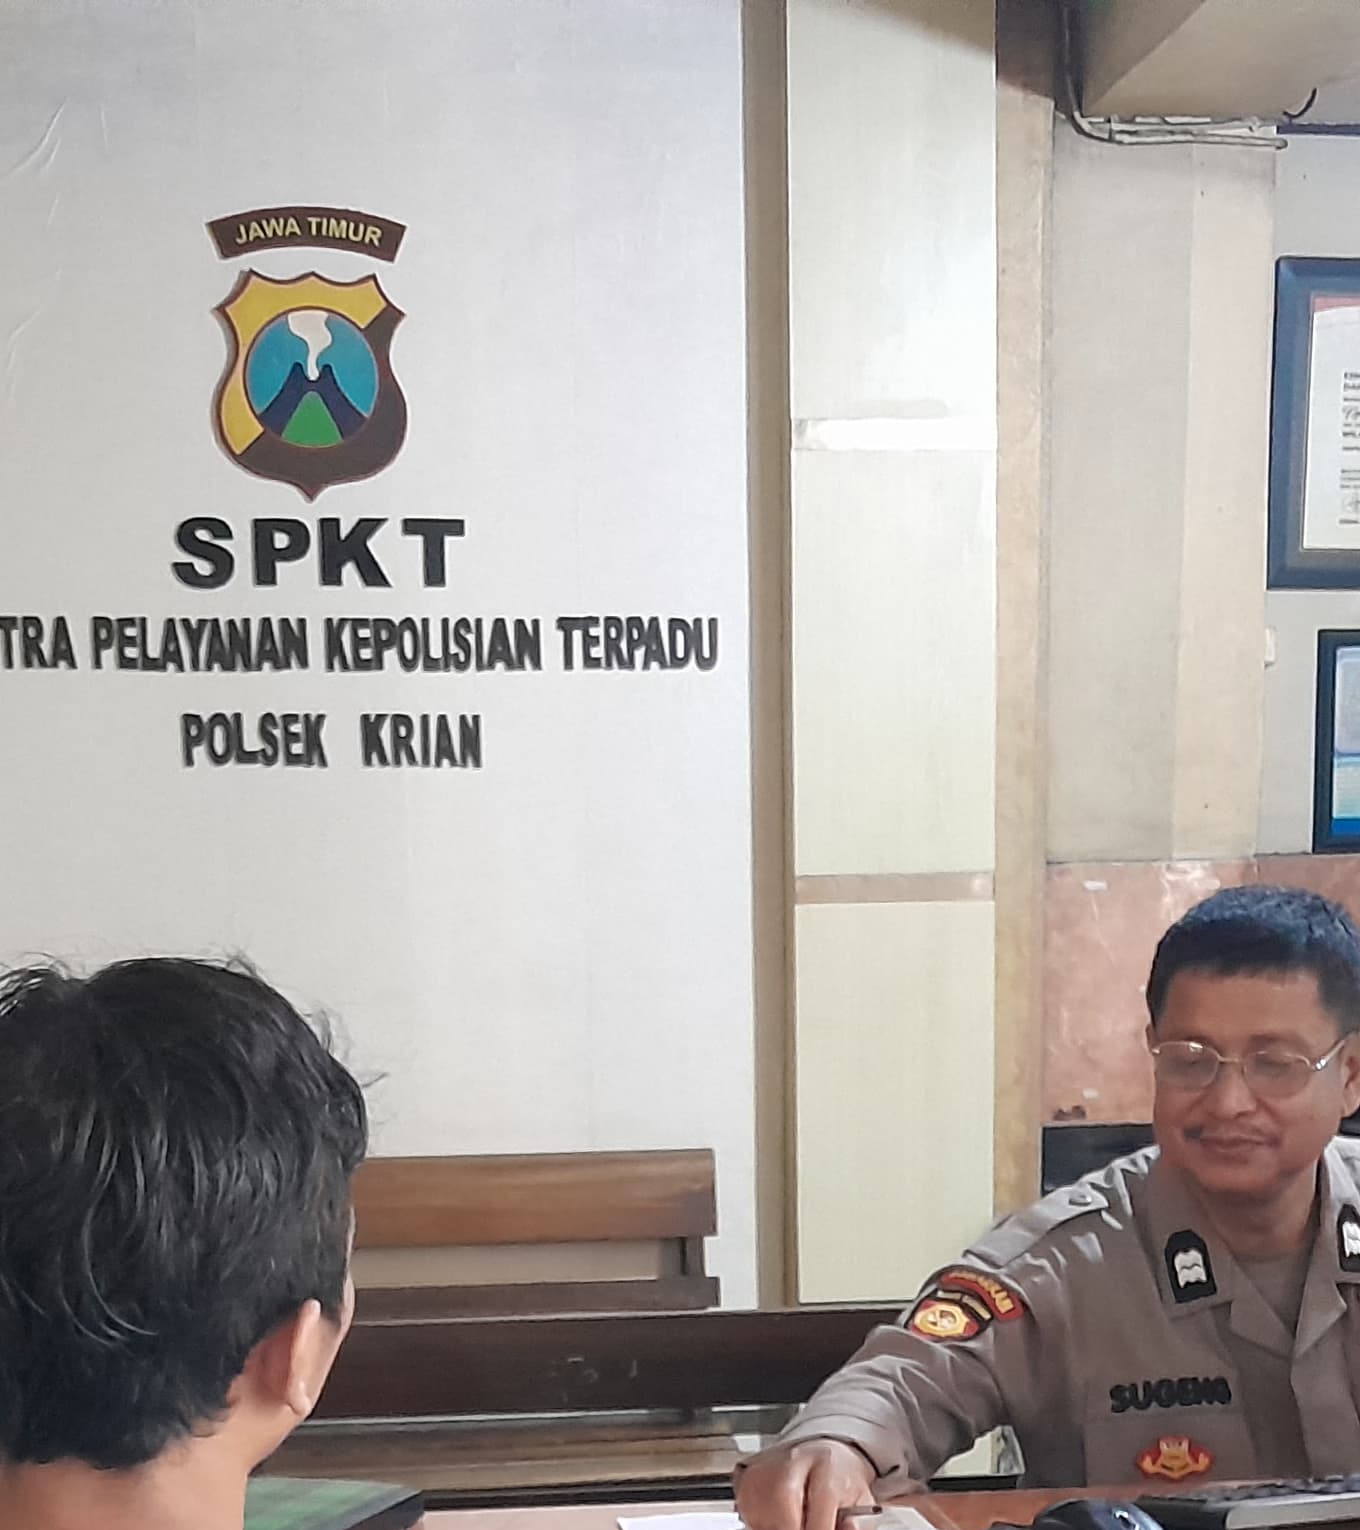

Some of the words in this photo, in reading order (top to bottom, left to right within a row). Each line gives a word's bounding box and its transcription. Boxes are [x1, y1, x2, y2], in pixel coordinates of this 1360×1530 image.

[236, 216, 301, 244] JAWA
[307, 217, 382, 247] TIMUR
[172, 516, 466, 590] SPKT
[92, 616, 310, 674] PELAYANAN
[324, 616, 543, 673] KEPOLISIAN
[557, 616, 720, 672] TERPADU
[181, 713, 329, 768] POLSEK
[360, 714, 482, 769] KRIAN
